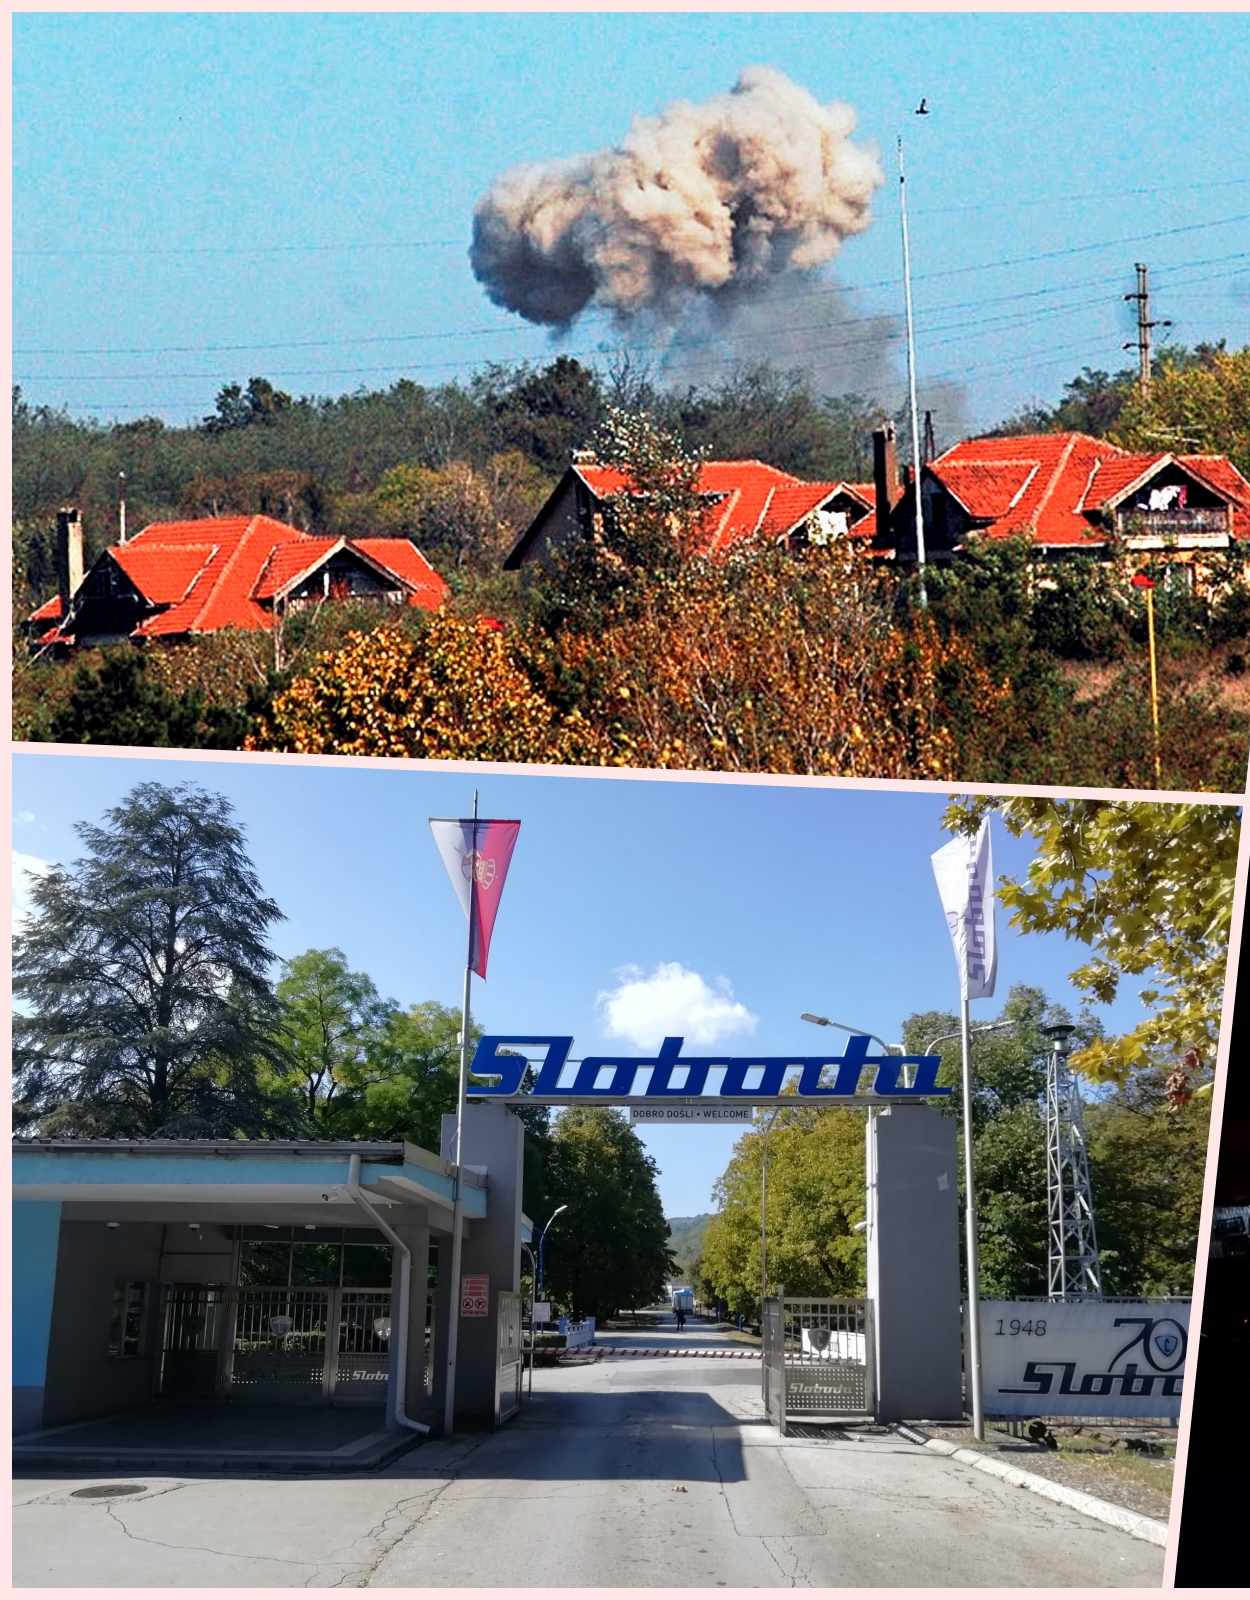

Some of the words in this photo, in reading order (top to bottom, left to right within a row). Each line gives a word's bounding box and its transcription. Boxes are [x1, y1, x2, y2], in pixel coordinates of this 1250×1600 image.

[466, 1035, 954, 1098] Sloboda
[632, 1110, 665, 1118] DOBRO
[667, 1108, 694, 1118] DOŠLI
[703, 1110, 749, 1118] WELCOME
[994, 1318, 1048, 1337] 1948
[1108, 1317, 1188, 1373] 70
[788, 1382, 854, 1394] Sloboda
